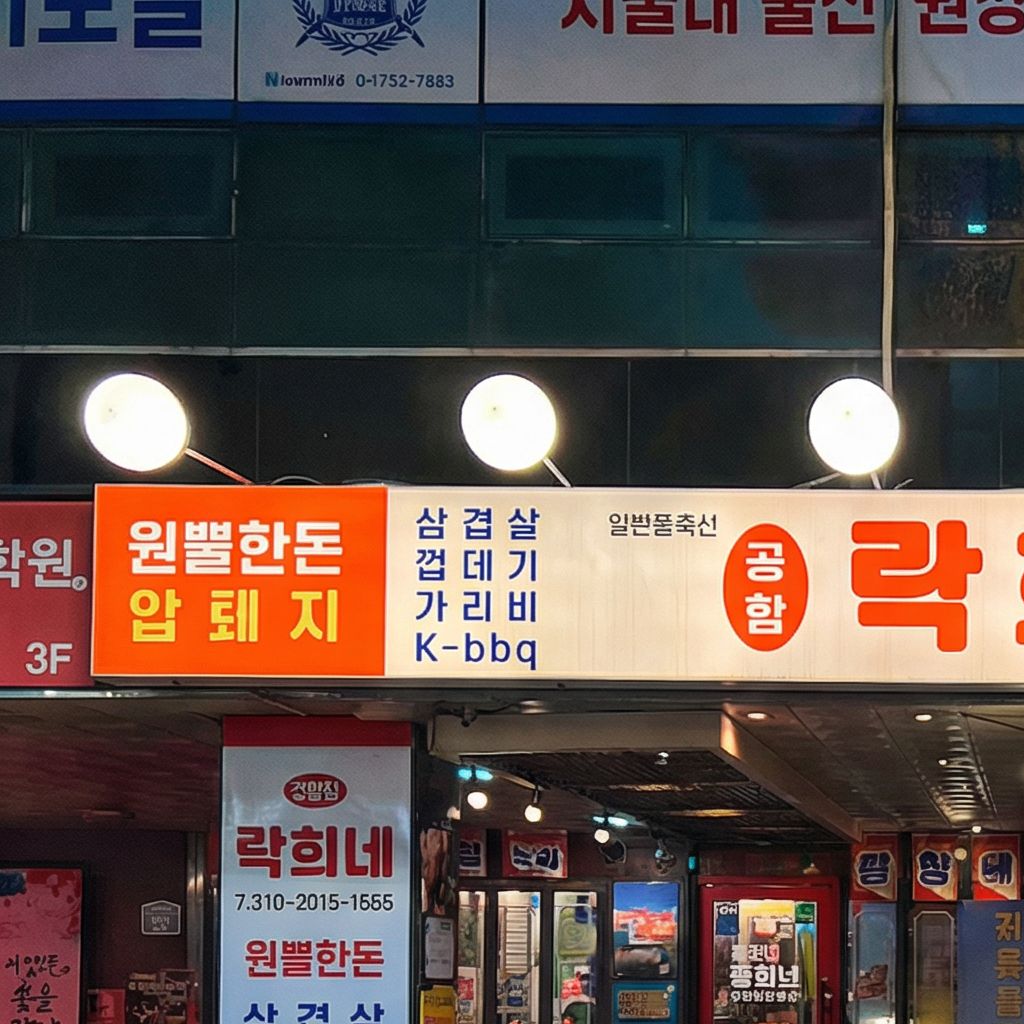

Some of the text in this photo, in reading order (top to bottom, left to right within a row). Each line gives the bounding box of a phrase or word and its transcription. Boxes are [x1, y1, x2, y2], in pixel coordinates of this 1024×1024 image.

[416, 590, 537, 622] 가리비
[25, 641, 73, 675] 3F
[416, 632, 537, 670] K-bbq
[235, 825, 394, 879] 락희네
